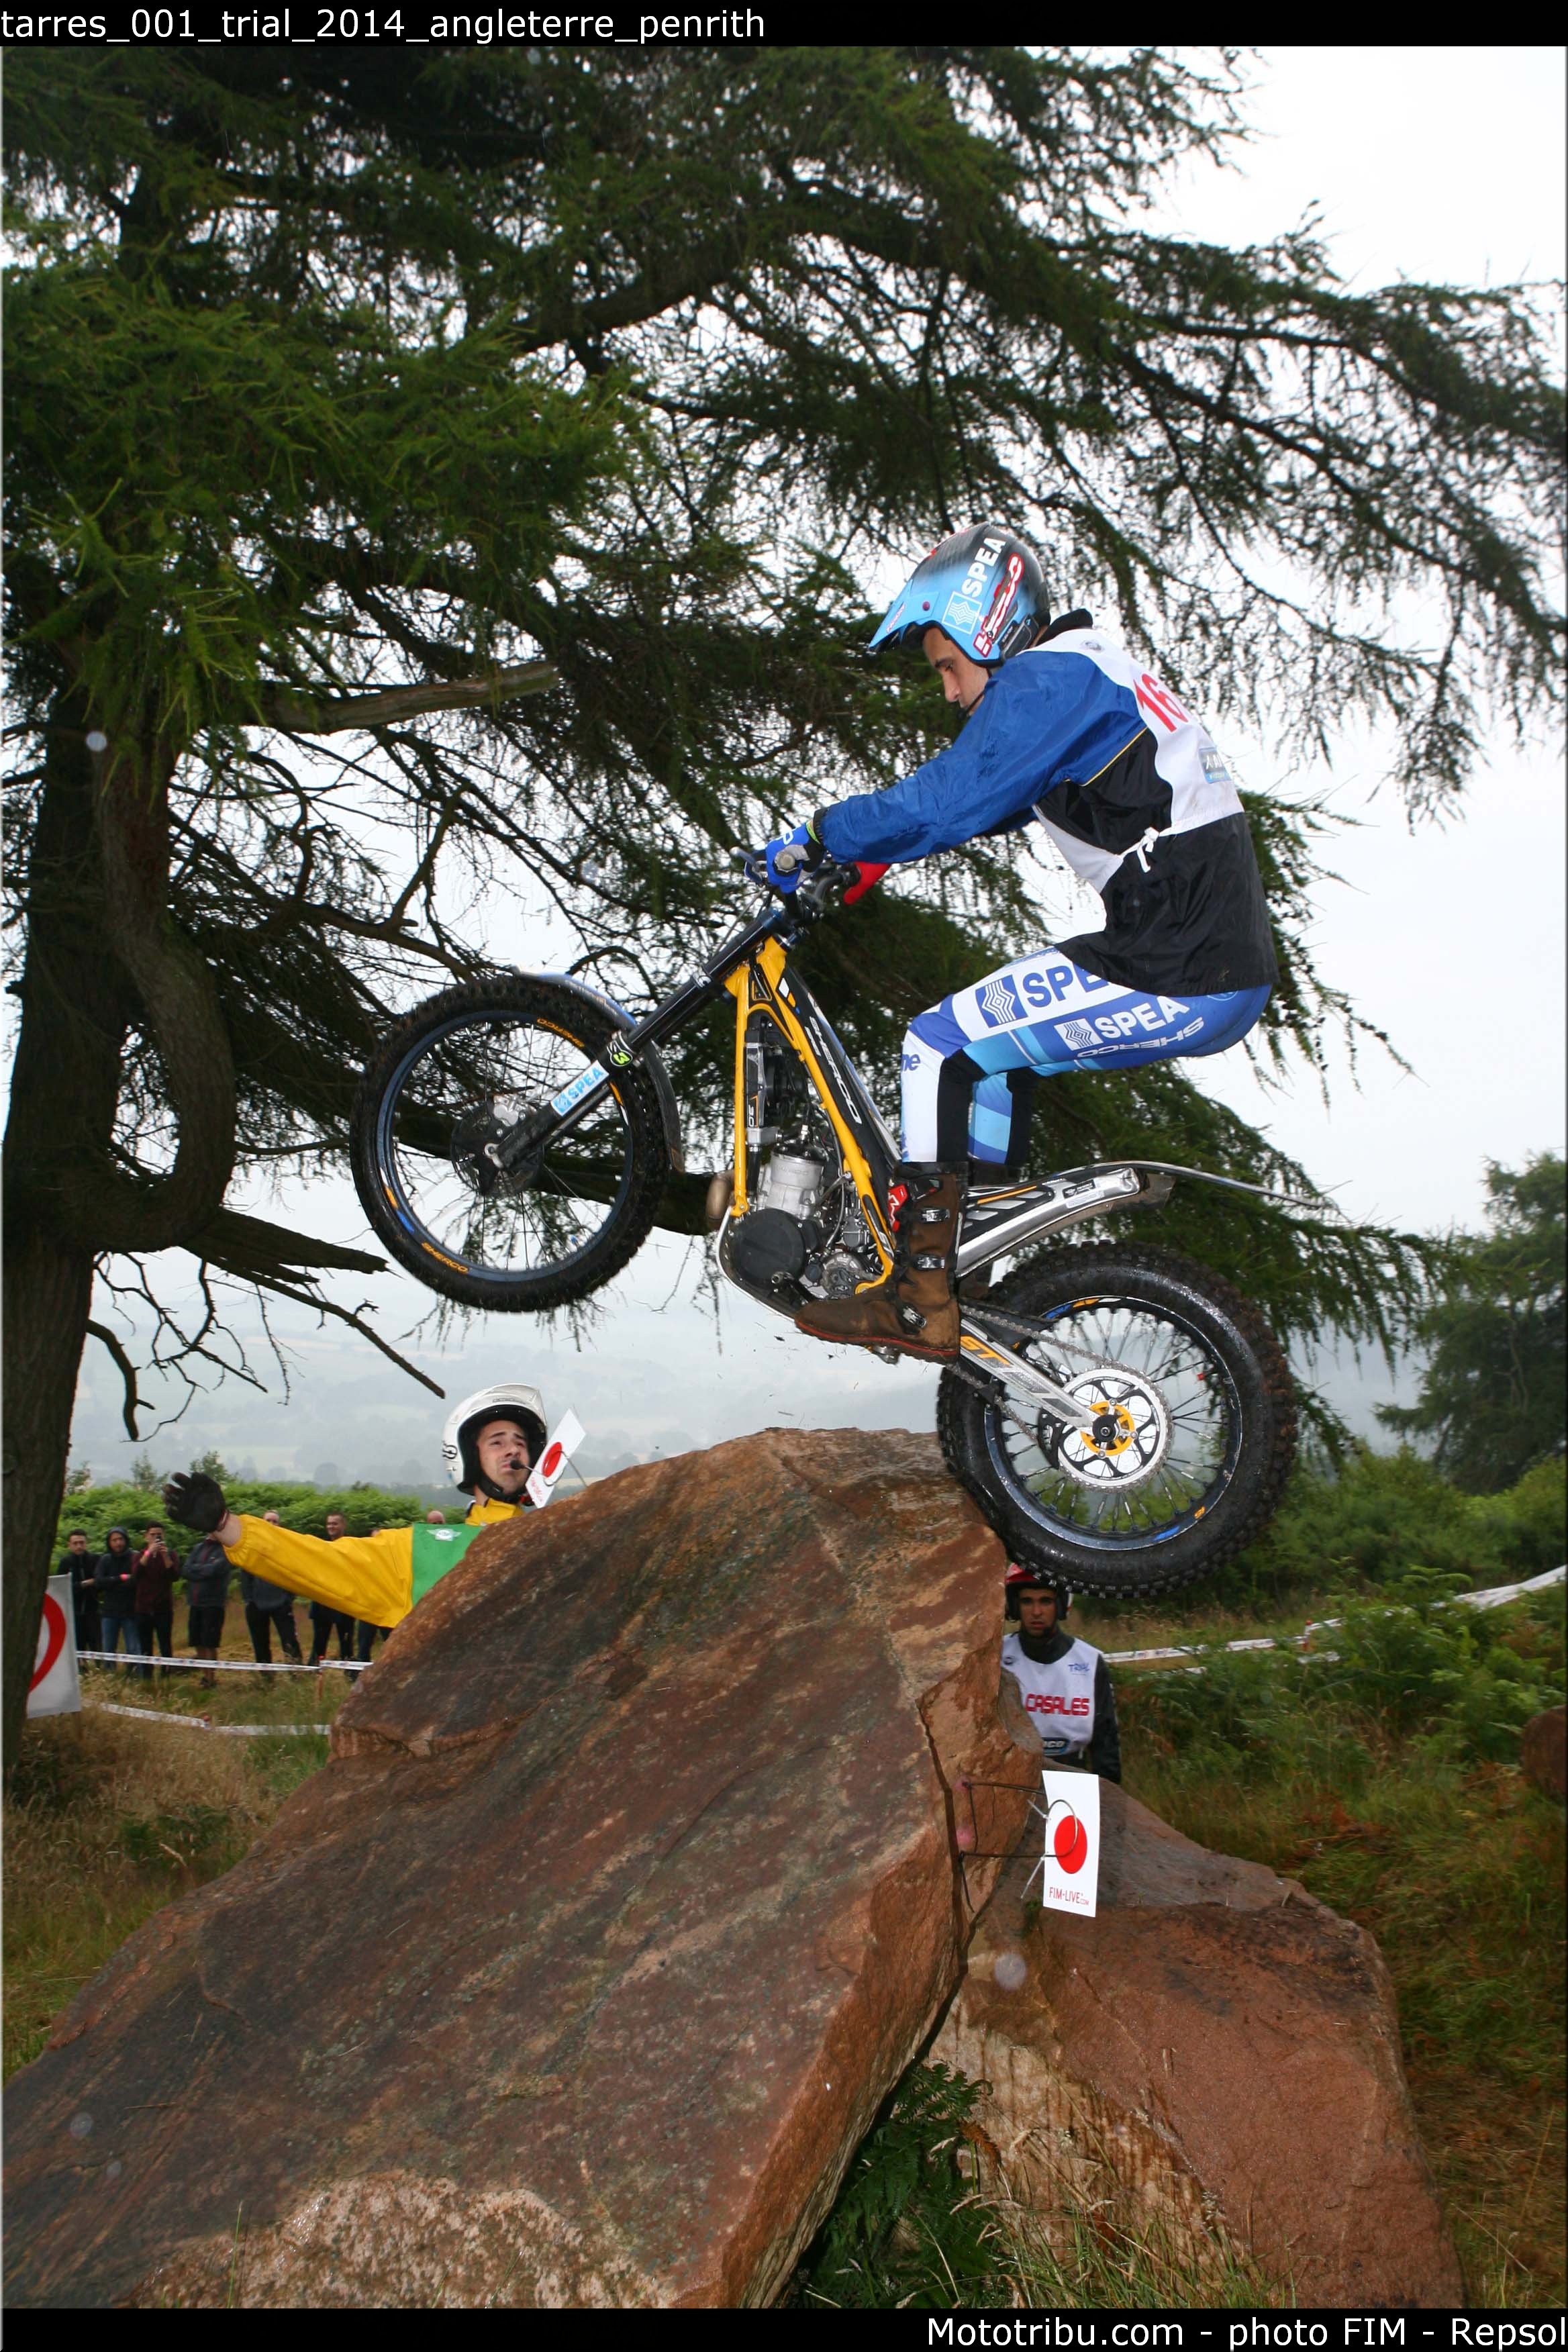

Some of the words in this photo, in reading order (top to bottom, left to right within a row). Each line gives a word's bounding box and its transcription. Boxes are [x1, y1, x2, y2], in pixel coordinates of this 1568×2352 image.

[961, 538, 1006, 598] SPEA
[1133, 673, 1189, 733] 16
[1077, 1016, 1205, 1058] SHERCO
[1094, 995, 1190, 1039] SPEA
[568, 1067, 603, 1099] SPEA
[809, 1016, 863, 1125] SHERCO
[421, 1242, 469, 1274] SHERCO
[1026, 1693, 1090, 1716] CASALES
